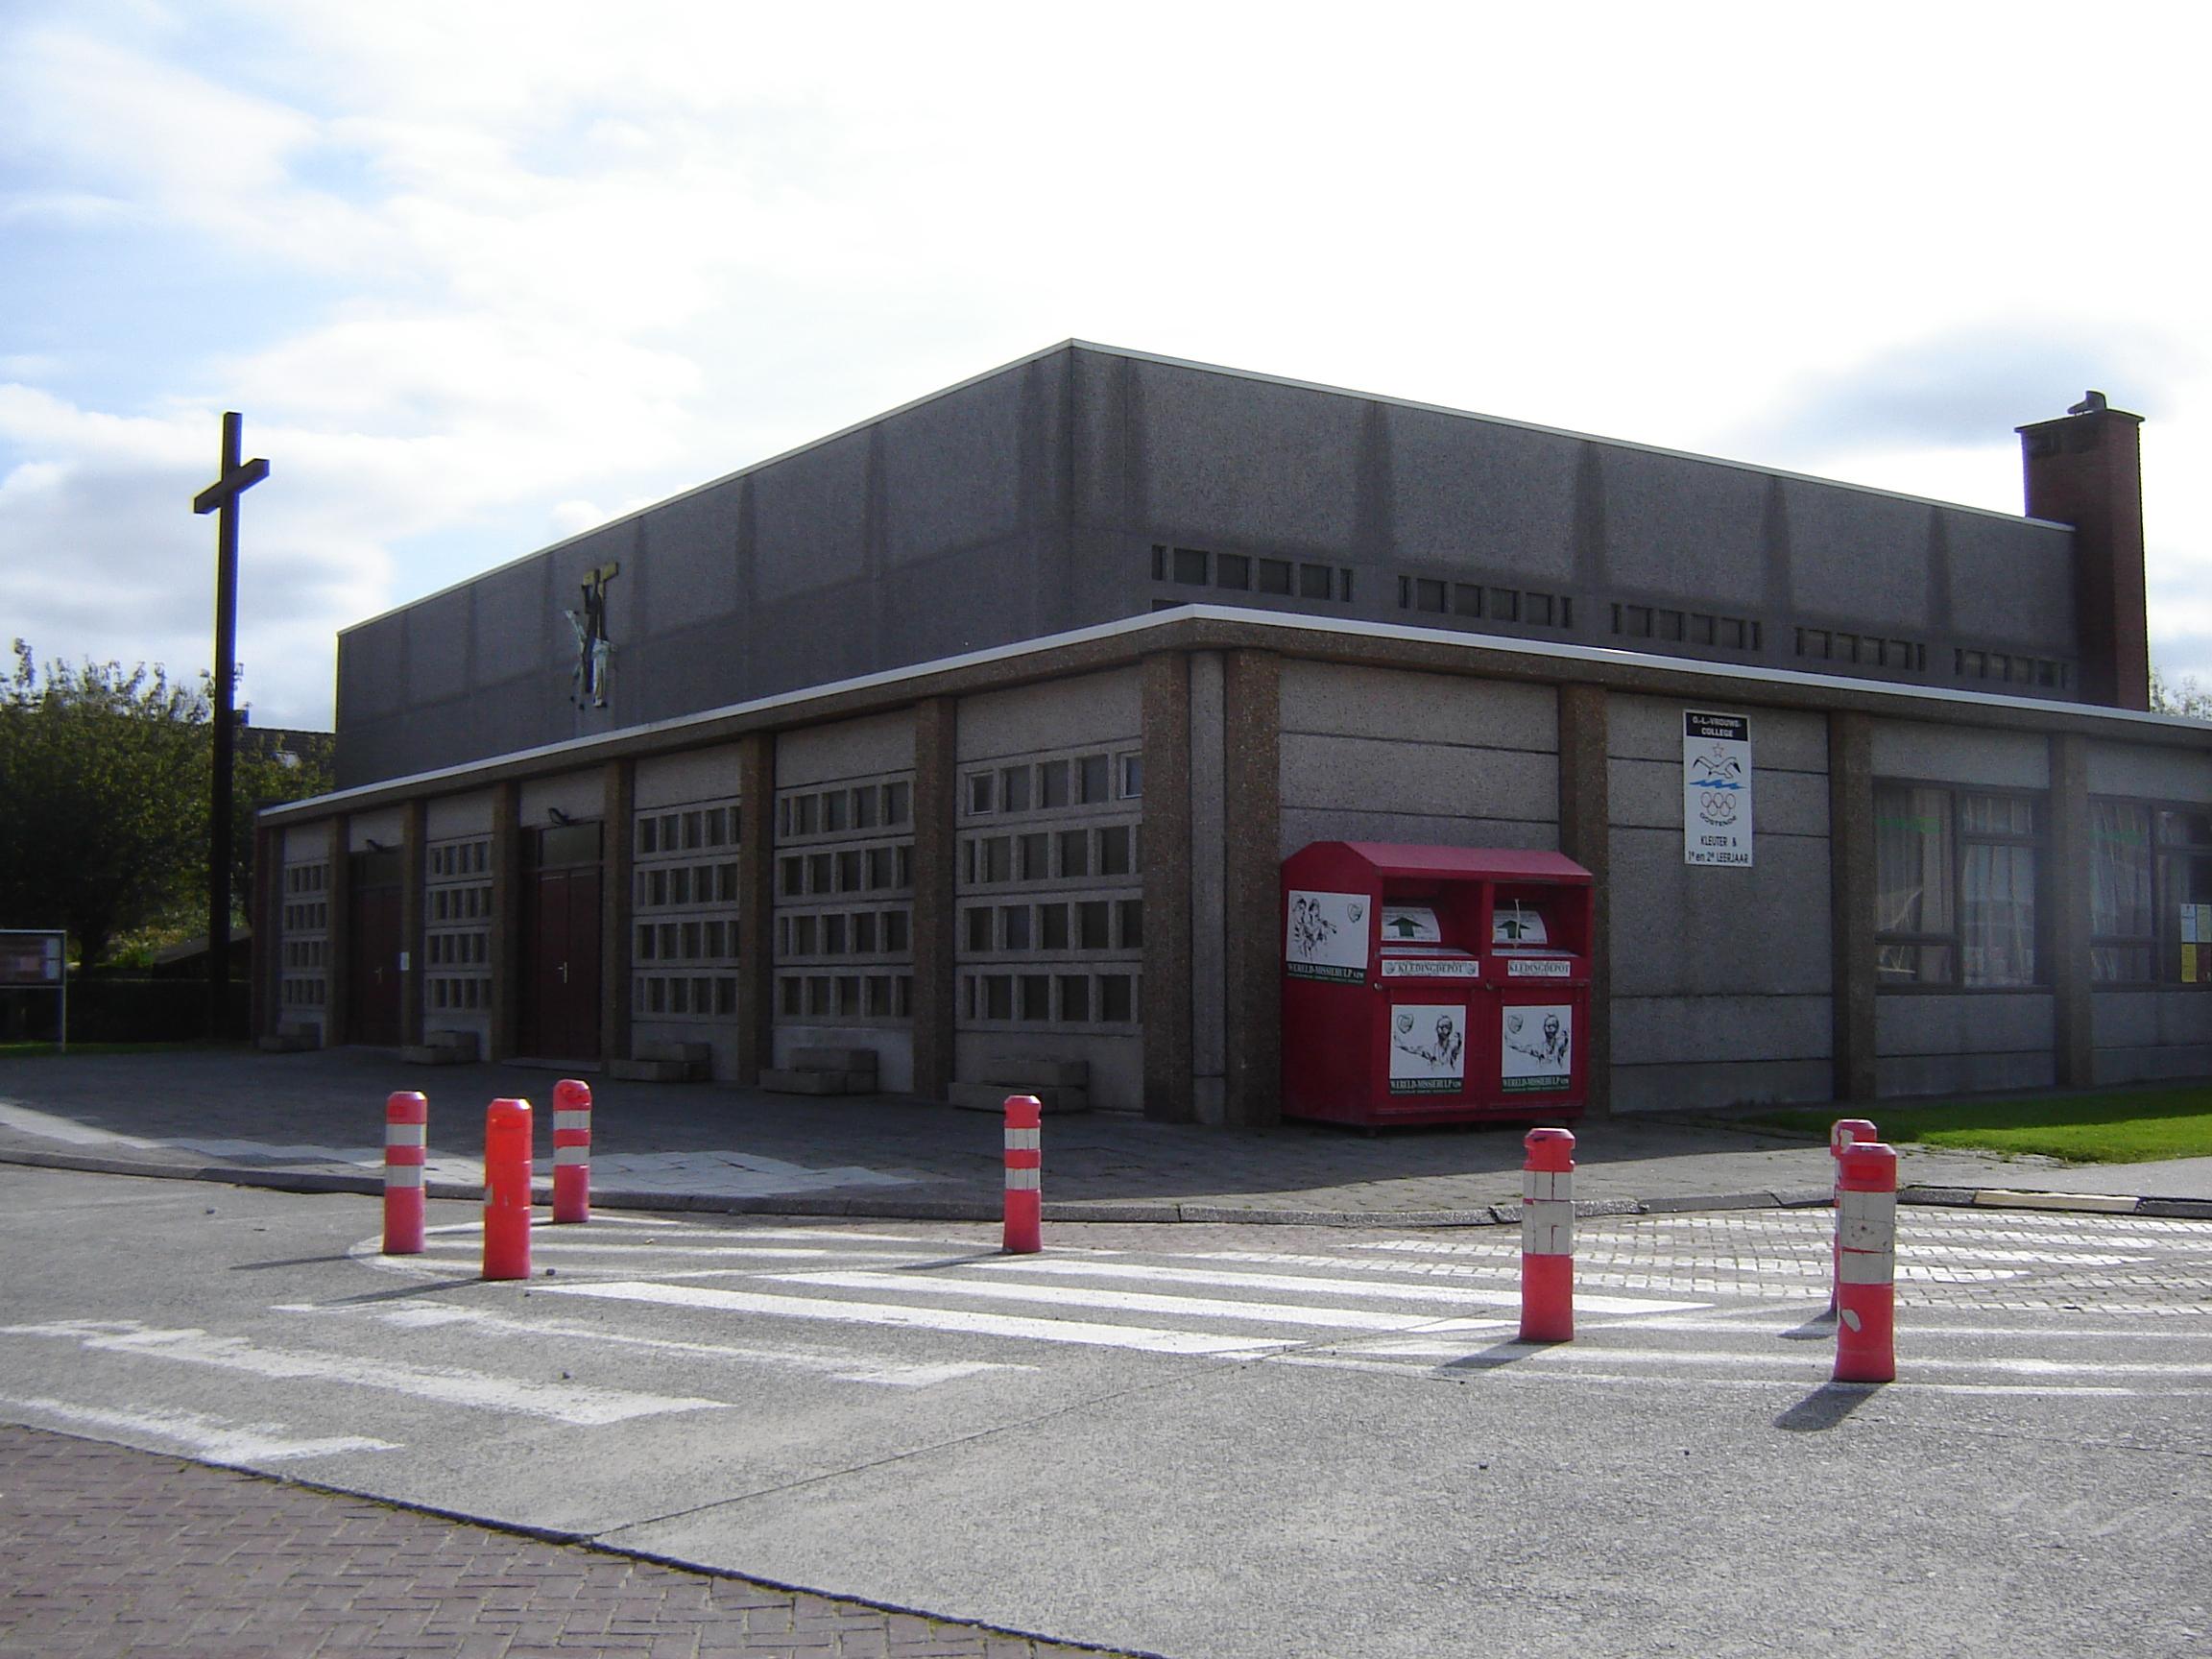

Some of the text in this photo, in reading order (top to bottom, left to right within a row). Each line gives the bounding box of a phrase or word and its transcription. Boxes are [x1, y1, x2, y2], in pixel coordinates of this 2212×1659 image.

[1701, 727, 1734, 737] COLLEGE
[1699, 811, 1737, 827] OOSTENDE
[1700, 835, 1728, 847] KLEUTER
[1695, 854, 1705, 862] en
[1716, 852, 1749, 863] LEERJAAR
[1398, 962, 1464, 974] KLEDINGDEPOT
[1509, 962, 1570, 974] KLEDINGDEPOT
